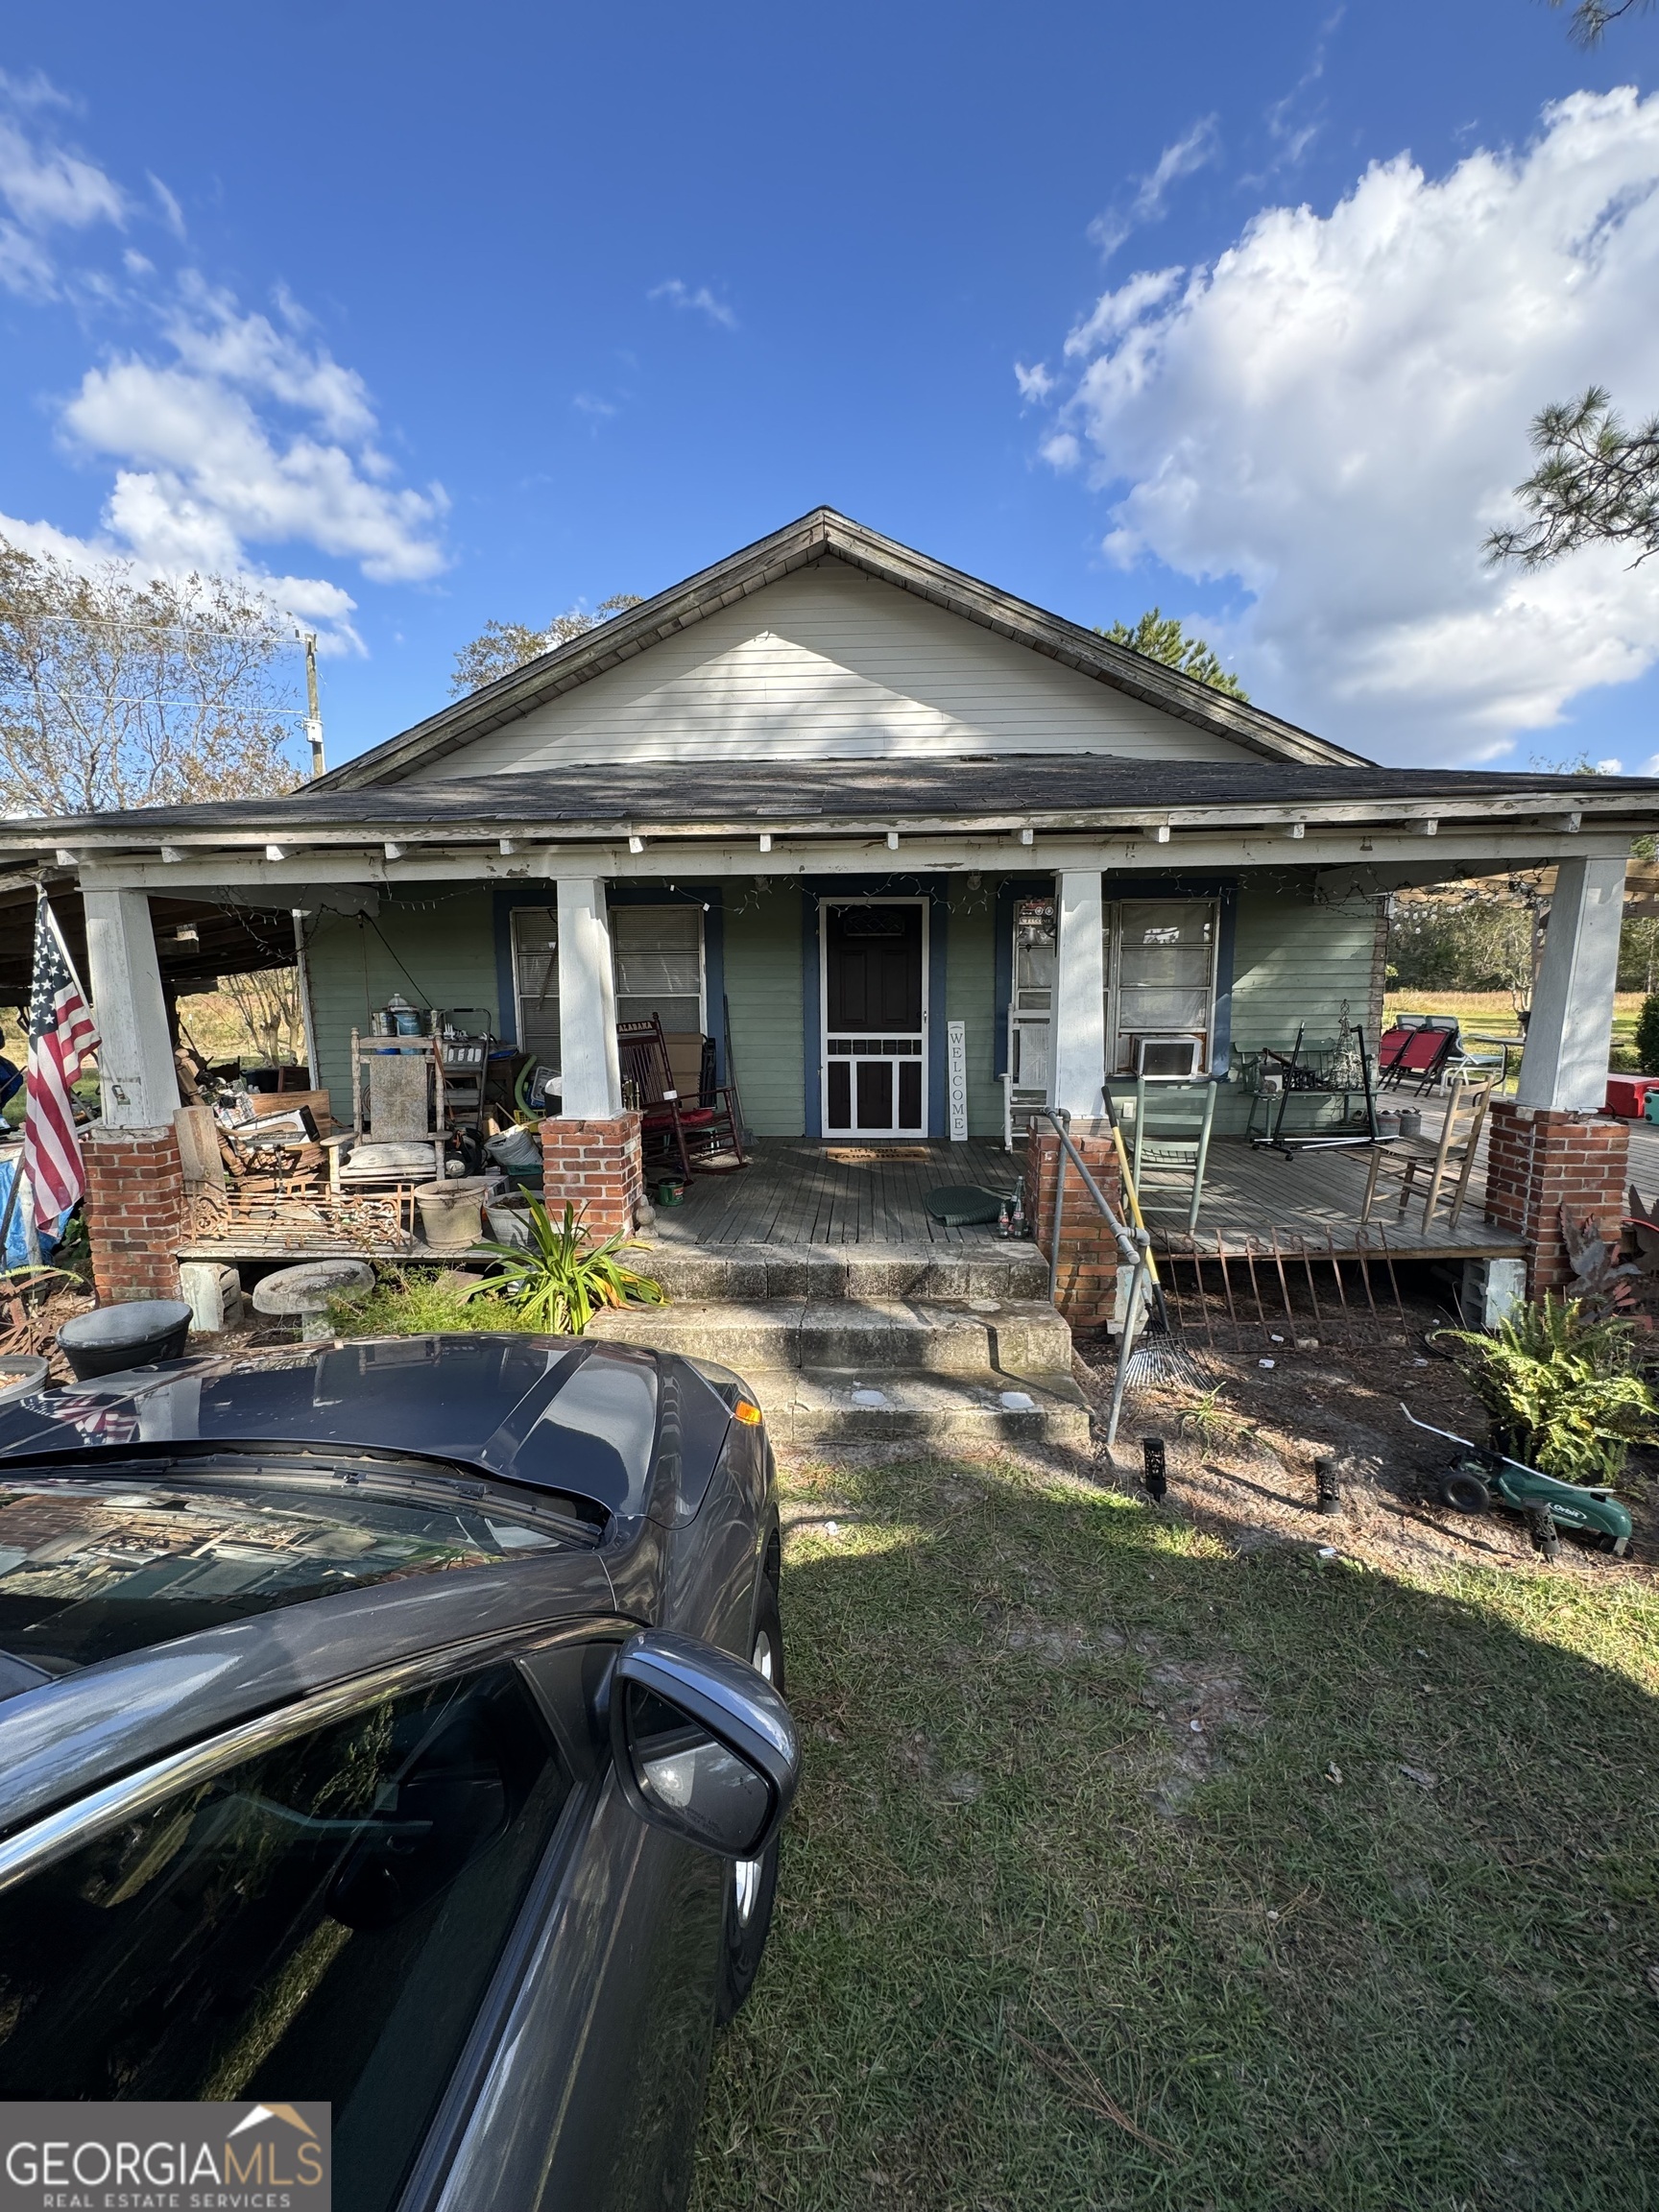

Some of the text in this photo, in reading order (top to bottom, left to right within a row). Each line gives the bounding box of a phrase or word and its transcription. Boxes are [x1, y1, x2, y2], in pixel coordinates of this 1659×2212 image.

[618, 1022, 653, 1032] ALABAMA
[950, 1033, 964, 1129] WELCOME
[1553, 1503, 1580, 1518] Orbit
